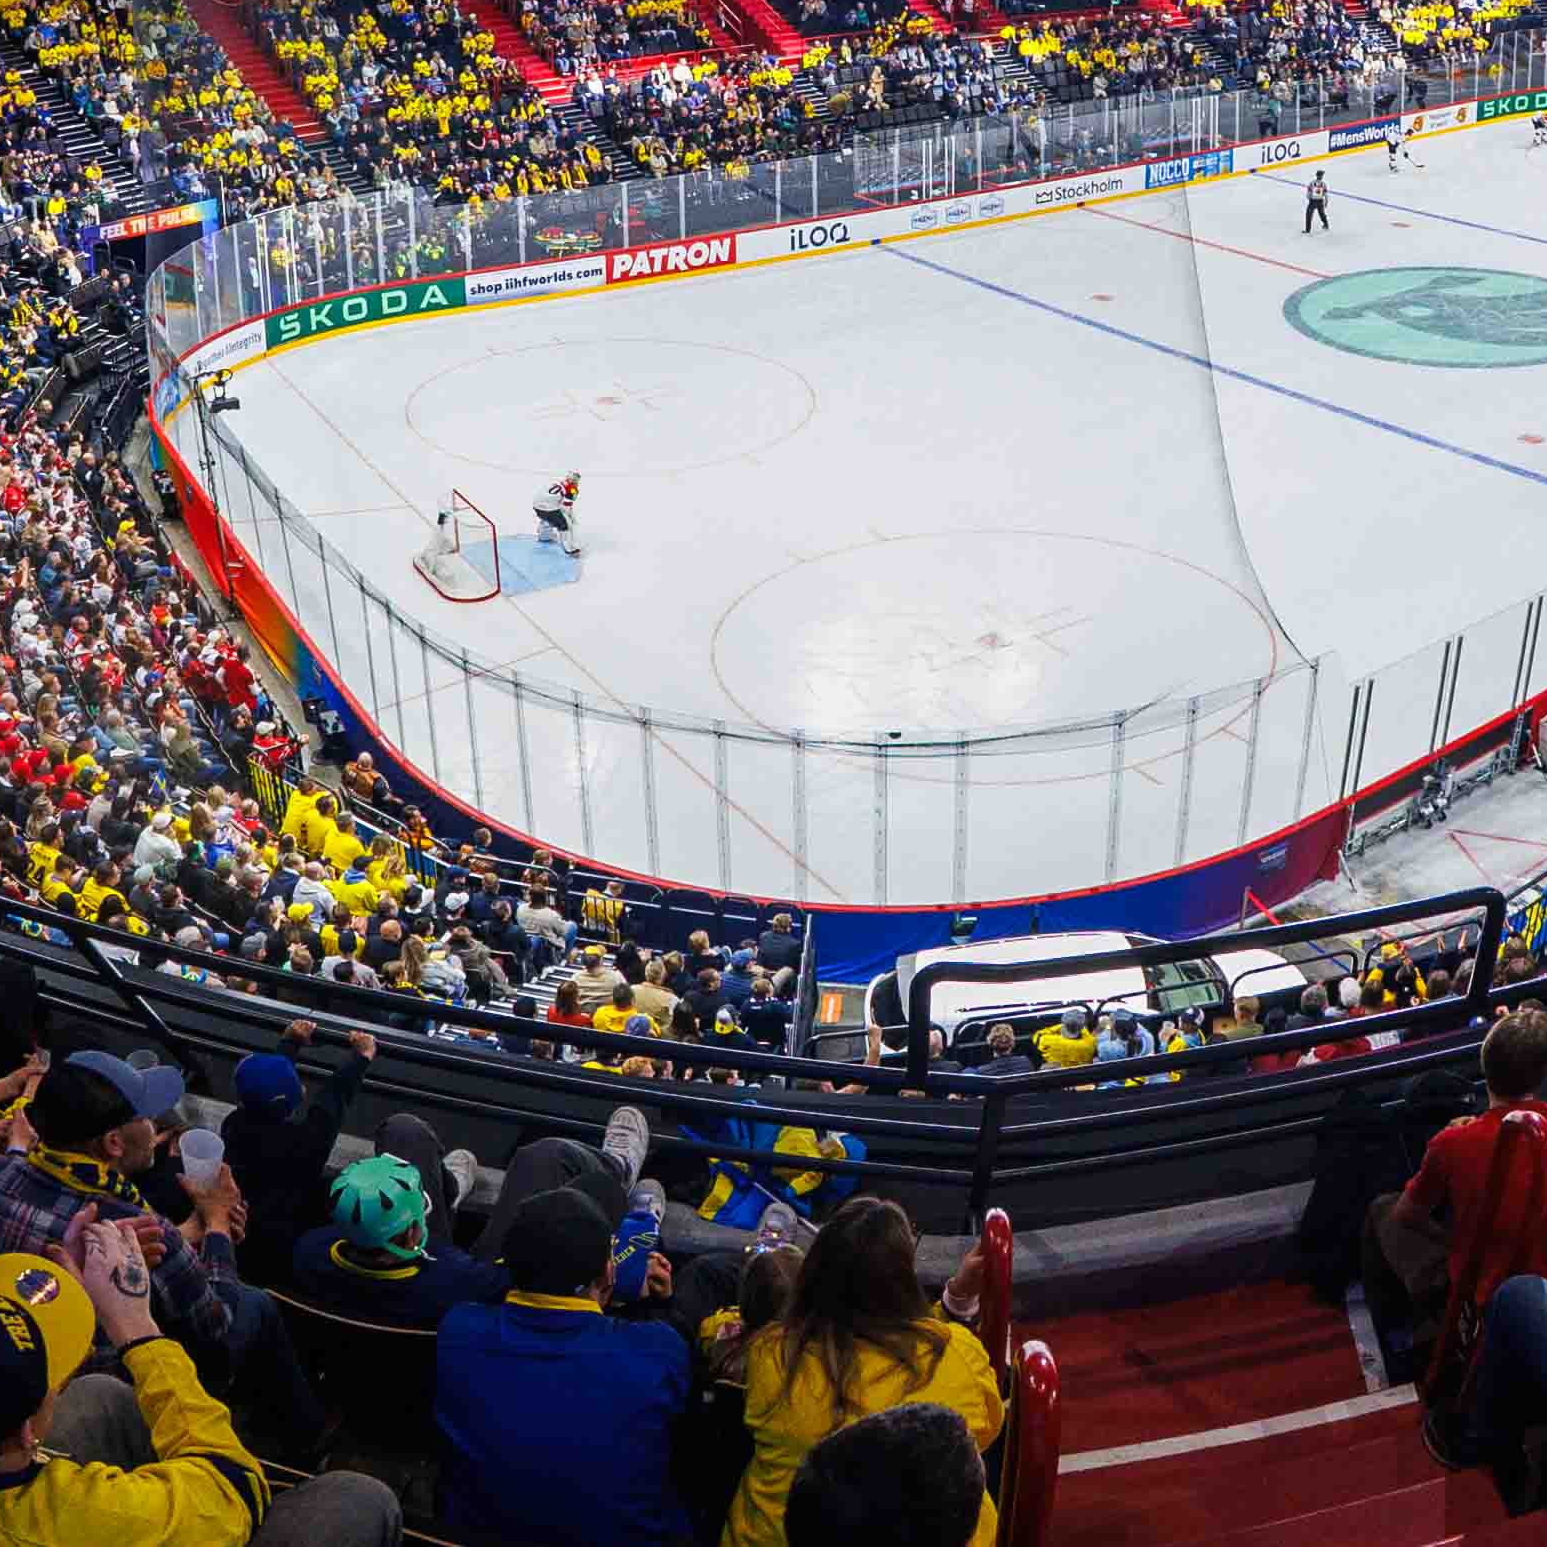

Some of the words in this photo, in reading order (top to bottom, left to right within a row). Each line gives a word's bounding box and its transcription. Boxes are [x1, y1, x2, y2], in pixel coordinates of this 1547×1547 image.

[1149, 157, 1190, 183] NOCCO
[1054, 177, 1123, 201] Stockholm
[789, 221, 851, 251] iLOQ
[612, 238, 732, 279] PATRON
